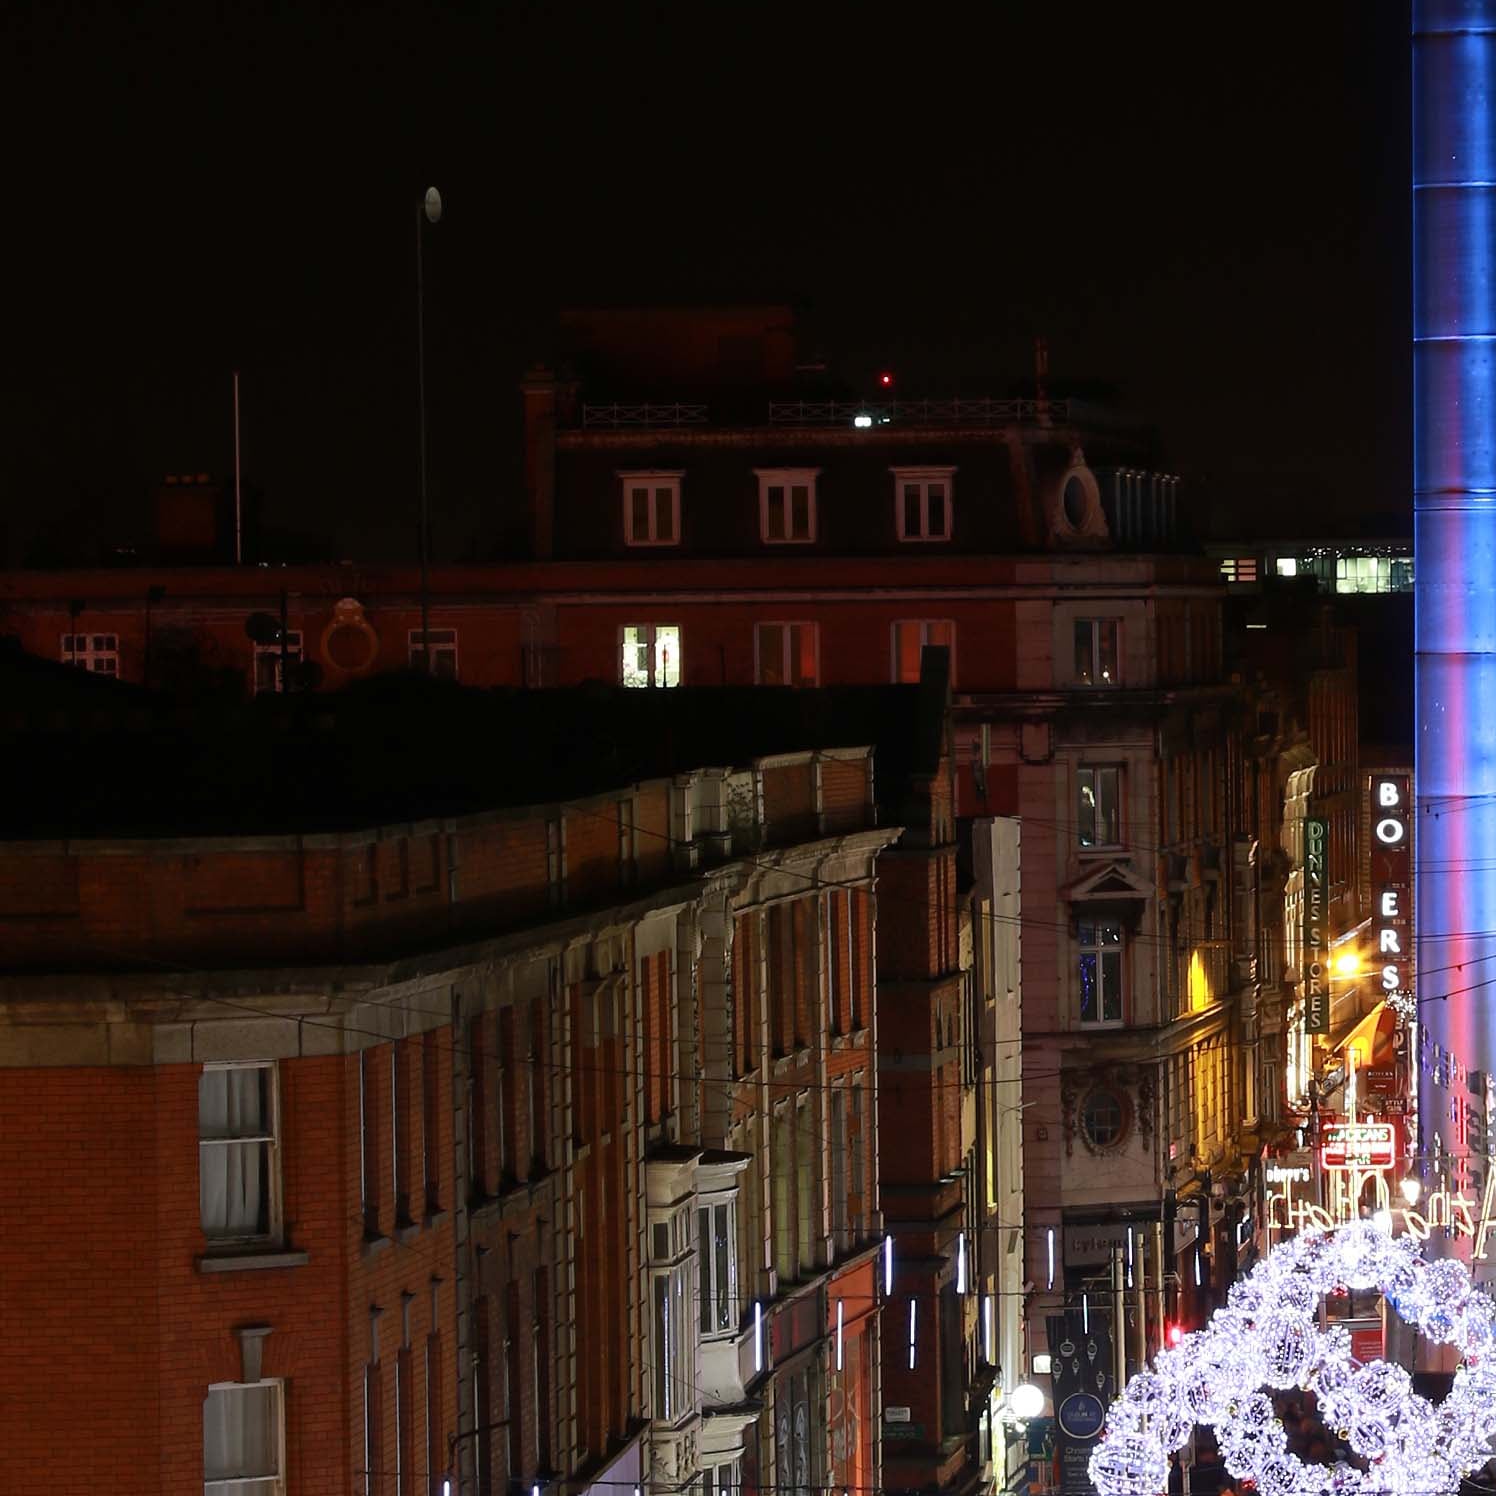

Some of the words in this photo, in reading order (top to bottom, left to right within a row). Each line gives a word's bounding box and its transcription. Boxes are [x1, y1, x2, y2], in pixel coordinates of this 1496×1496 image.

[1308, 821, 1324, 922] DUNNES
[1376, 782, 1403, 990] BOYERS
[1308, 927, 1323, 1029] STORES
